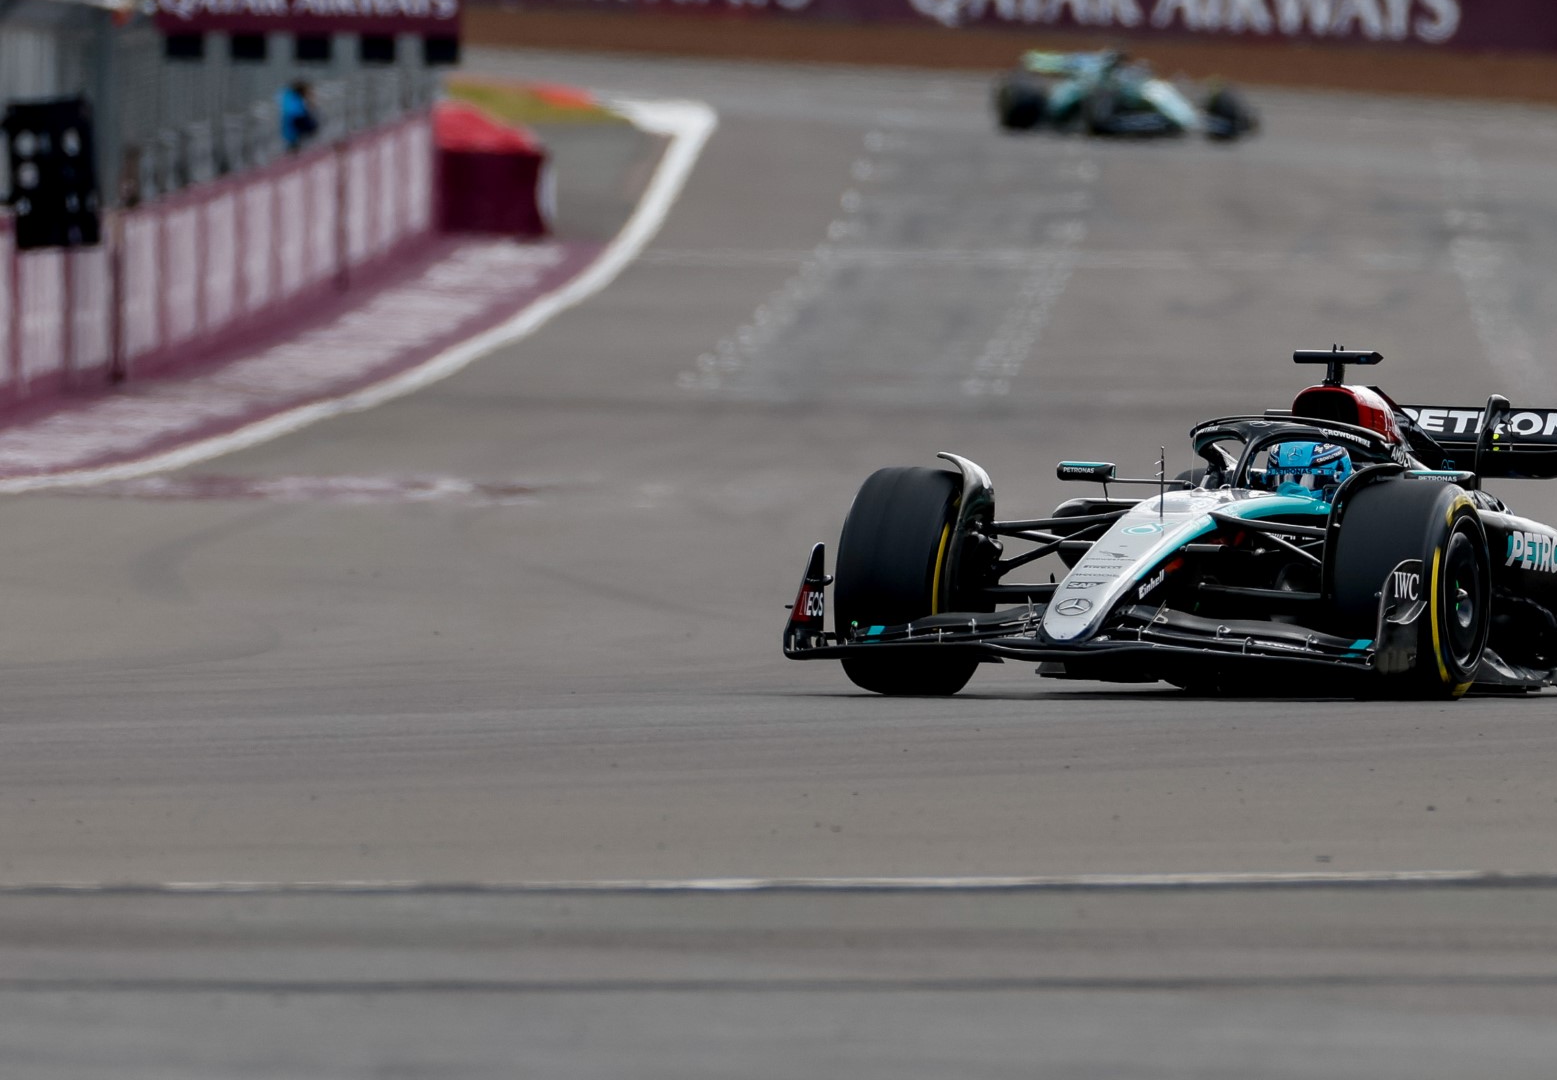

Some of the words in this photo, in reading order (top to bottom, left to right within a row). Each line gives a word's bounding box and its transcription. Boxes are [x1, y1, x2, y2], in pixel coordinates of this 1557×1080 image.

[1067, 581, 1101, 589] SAP
[1138, 569, 1165, 600] Einhell
[1394, 571, 1420, 601] IWC
